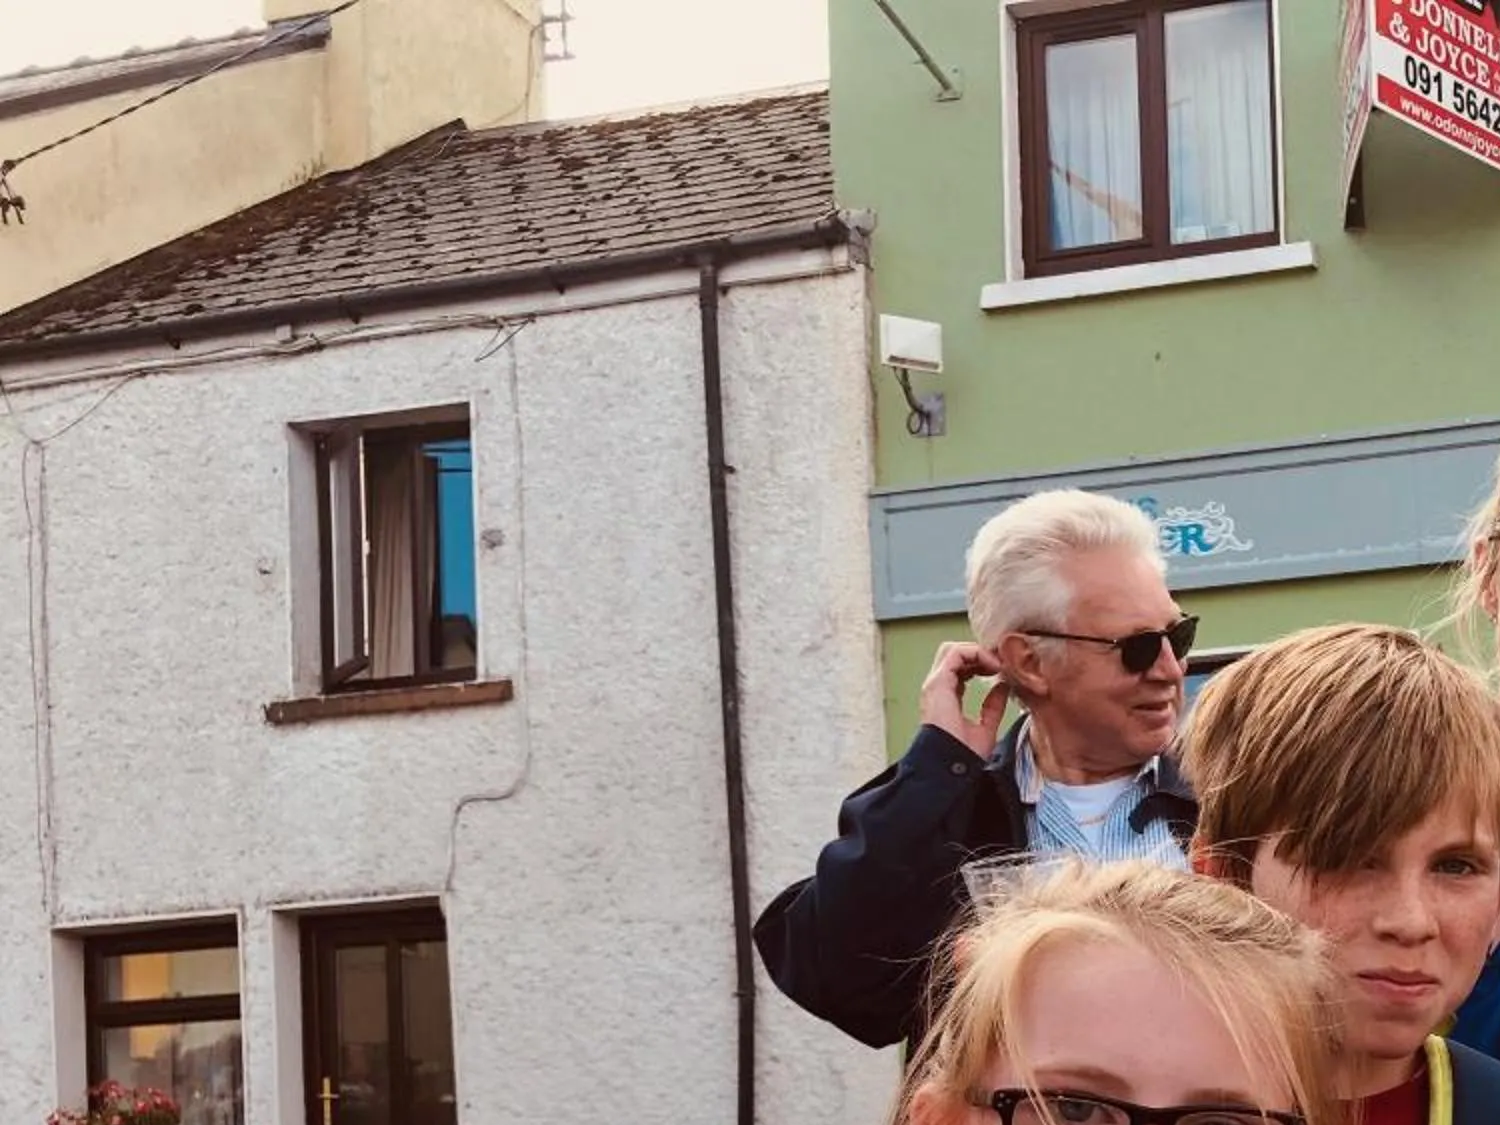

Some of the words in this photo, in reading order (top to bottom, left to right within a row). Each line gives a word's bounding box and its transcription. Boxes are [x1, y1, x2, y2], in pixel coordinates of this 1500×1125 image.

[1389, 12, 1411, 44] &
[1415, 27, 1491, 90] JOYCE
[1404, 55, 1444, 103] 091
